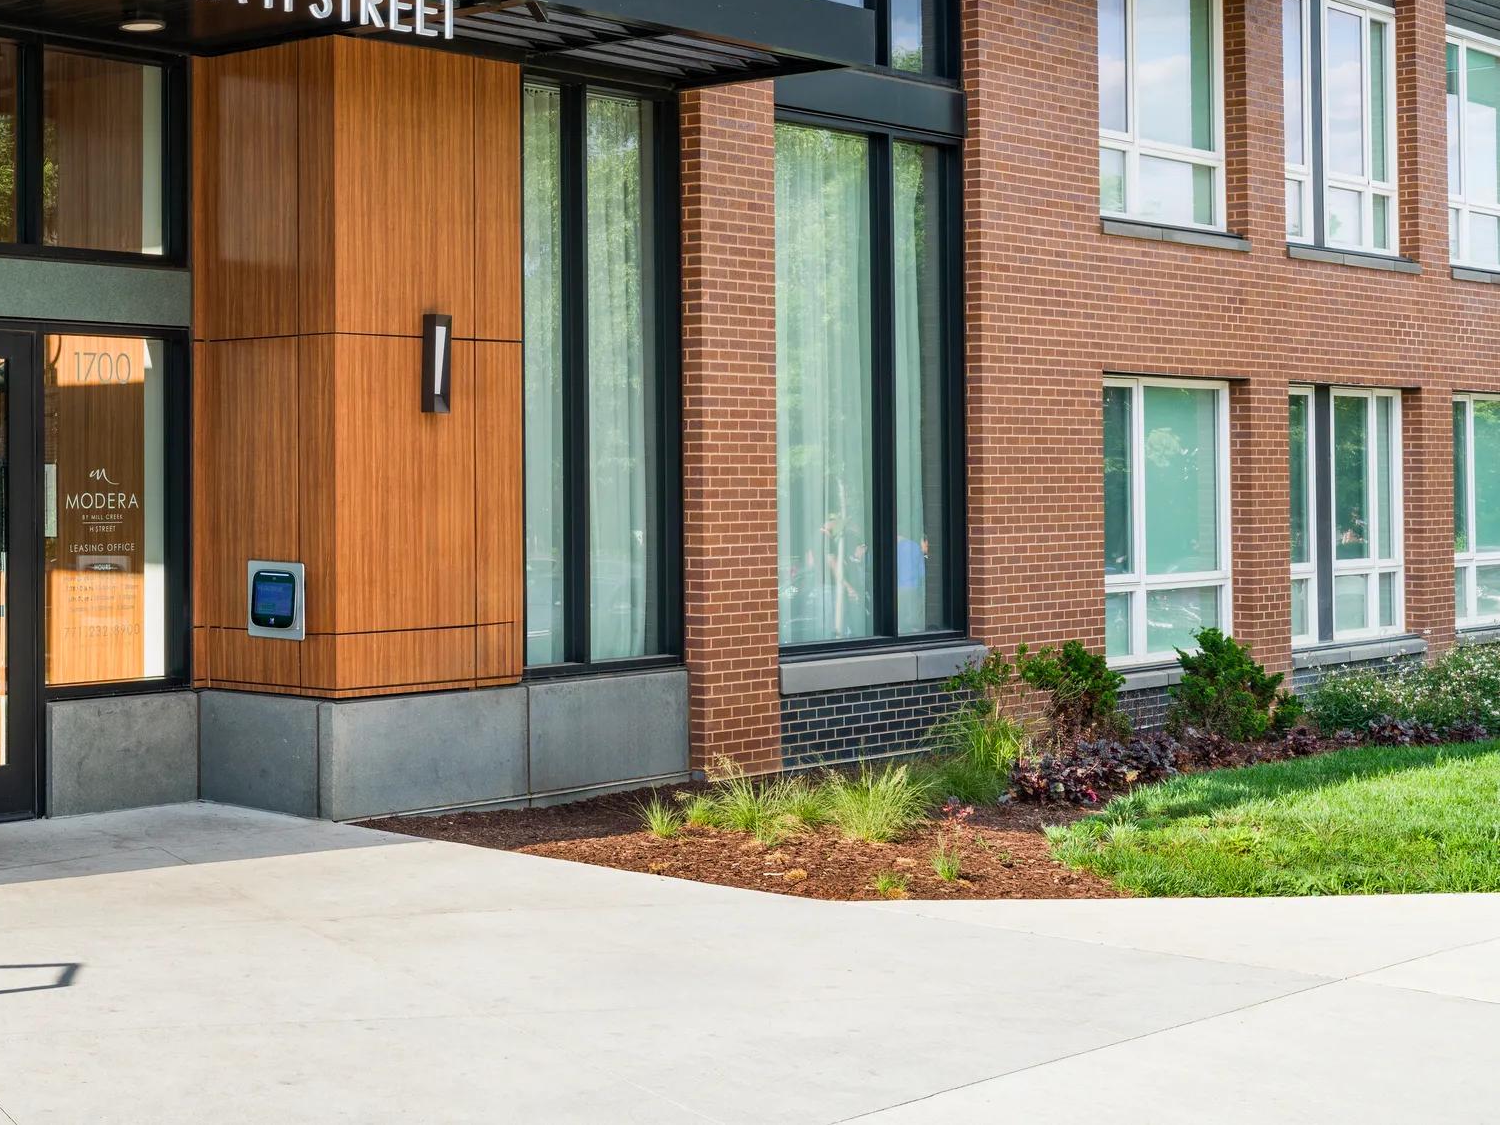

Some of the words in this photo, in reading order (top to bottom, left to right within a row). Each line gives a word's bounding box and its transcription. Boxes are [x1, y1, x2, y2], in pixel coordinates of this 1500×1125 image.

[73, 351, 131, 384] 1700
[65, 492, 139, 510] MODERA
[69, 543, 104, 553] LEASING
[106, 542, 135, 552] OFFICE
